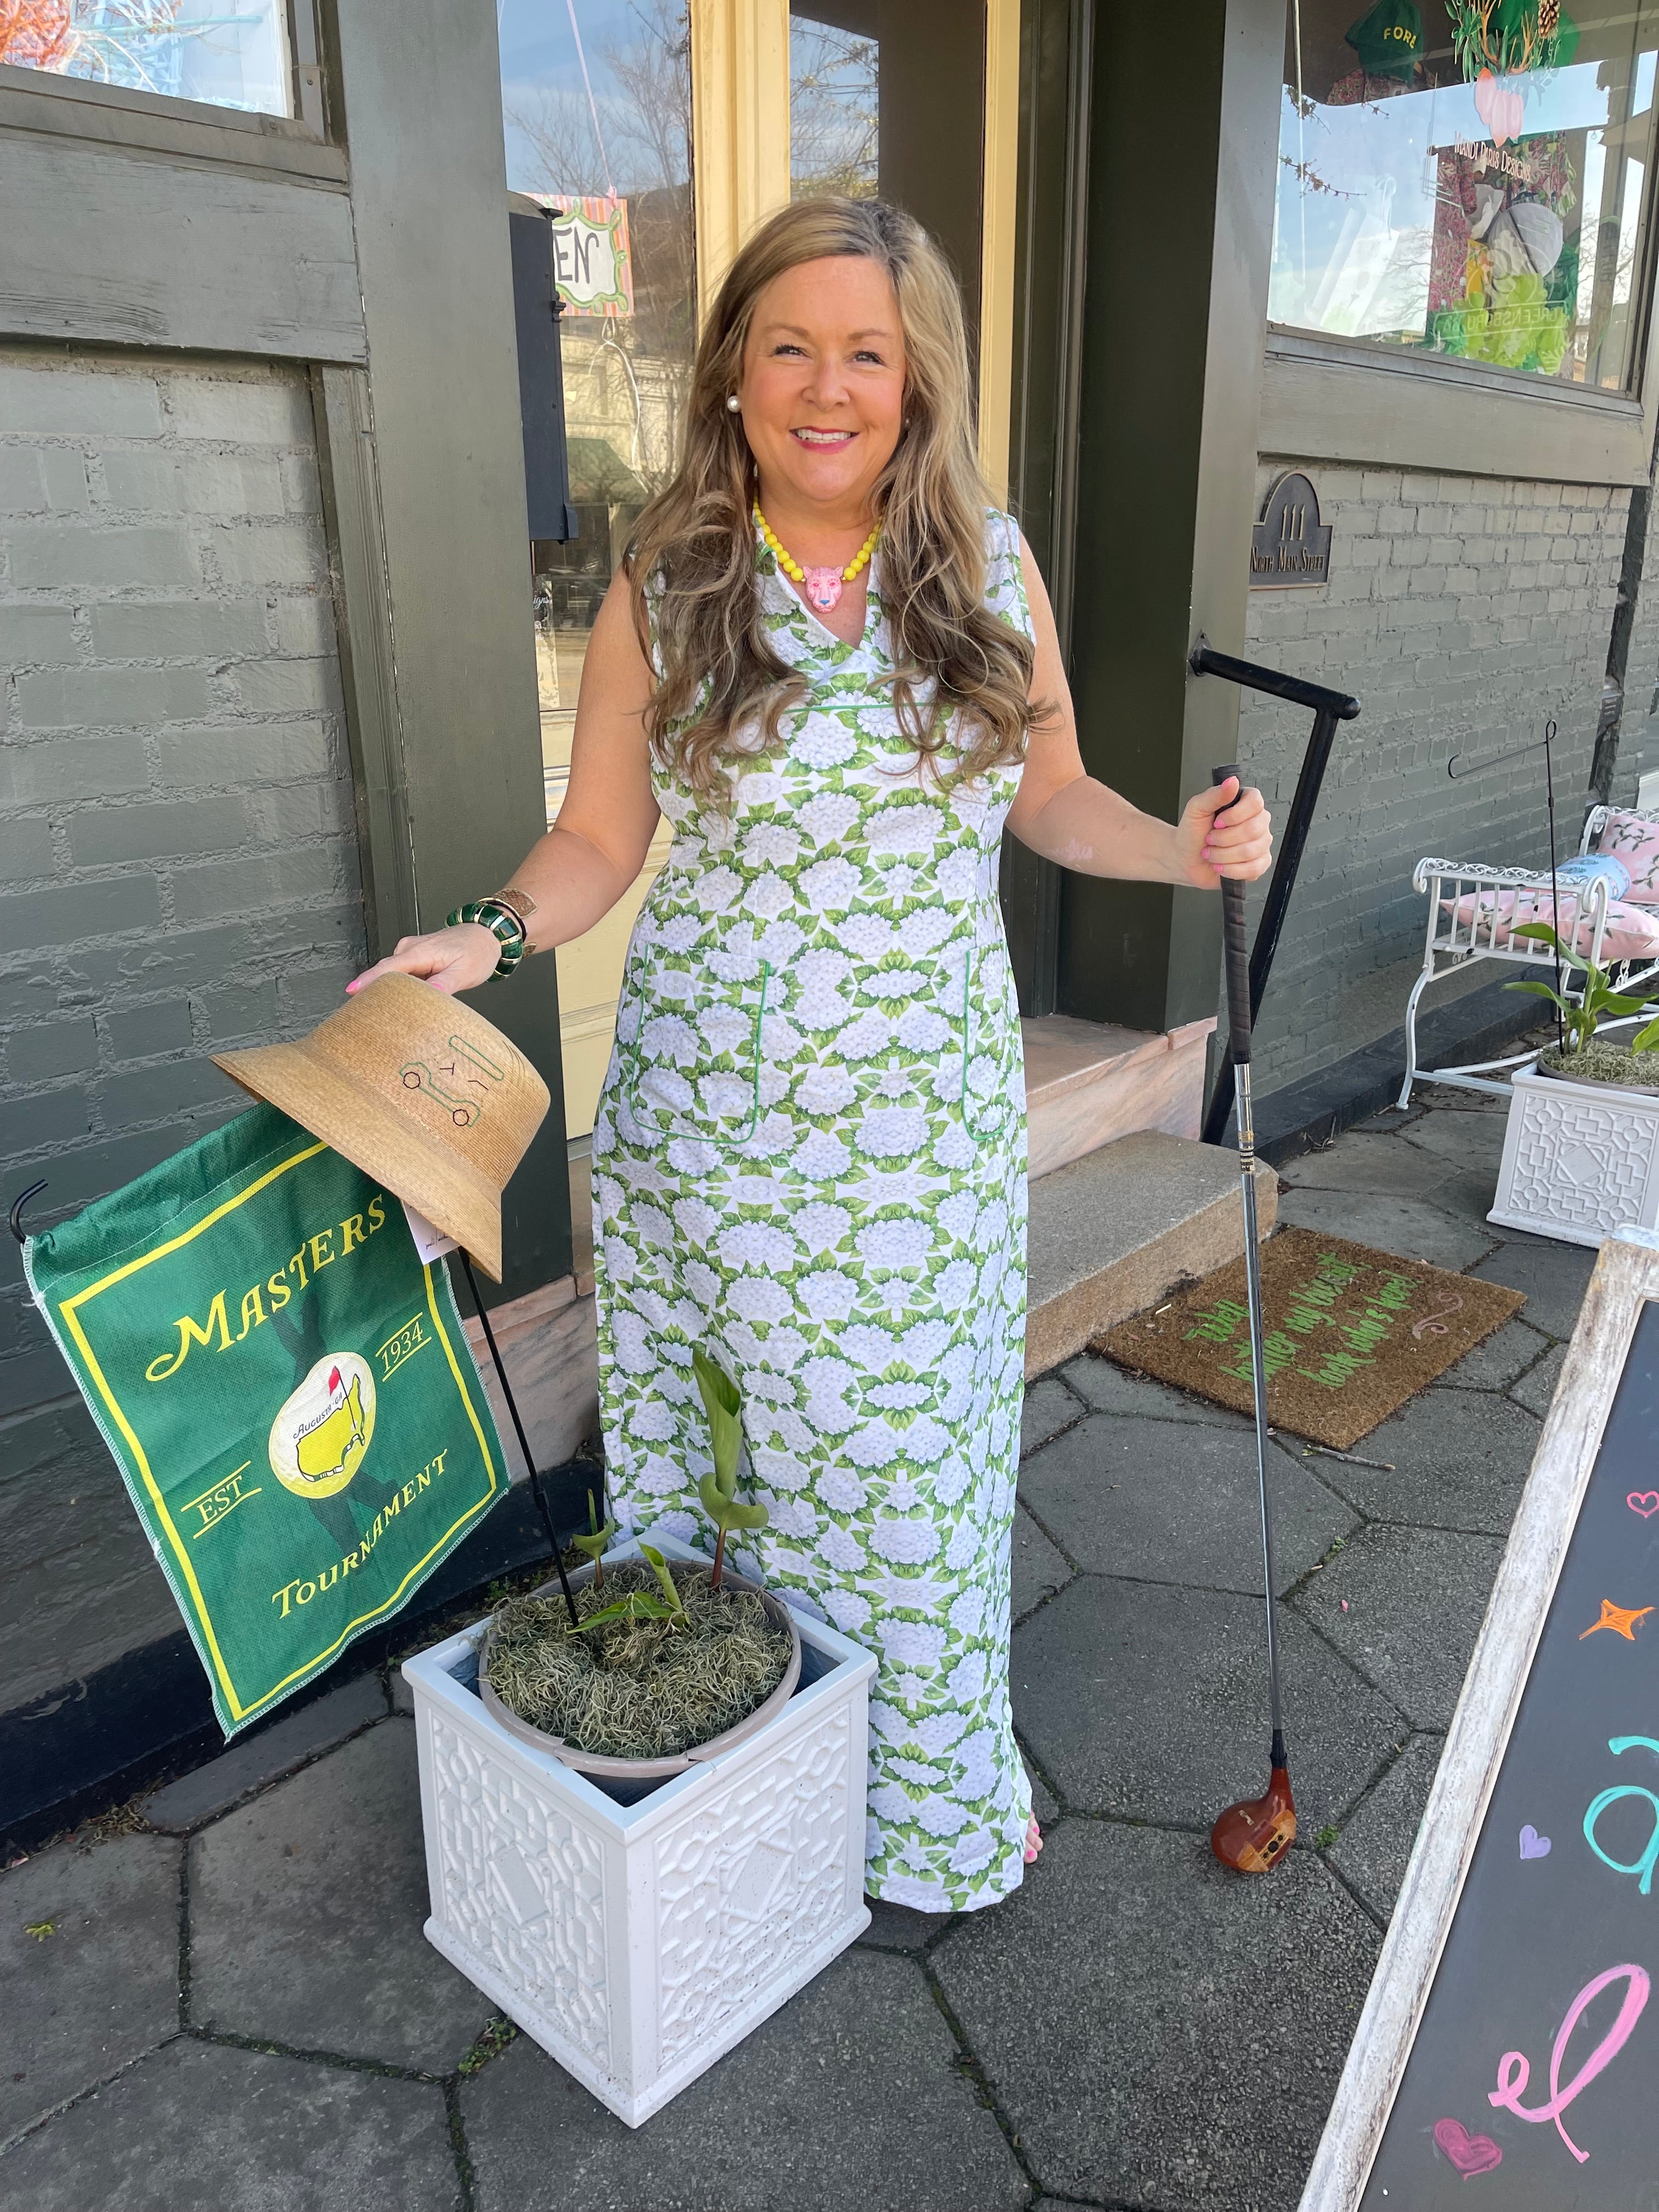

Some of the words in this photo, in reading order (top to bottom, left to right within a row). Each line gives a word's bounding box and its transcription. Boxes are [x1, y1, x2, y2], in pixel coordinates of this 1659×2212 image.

[552, 226, 600, 285] EN
[1280, 504, 1306, 541] 111
[1277, 546, 1298, 572] MAIN
[1300, 547, 1326, 572] STREET
[145, 1194, 387, 1382] MASTERS
[1283, 1305, 1336, 1334] my
[381, 1319, 425, 1376] 1934
[1296, 1351, 1376, 1387] look
[199, 1474, 246, 1525] EST
[272, 1448, 448, 1620] TOURNAMENT
